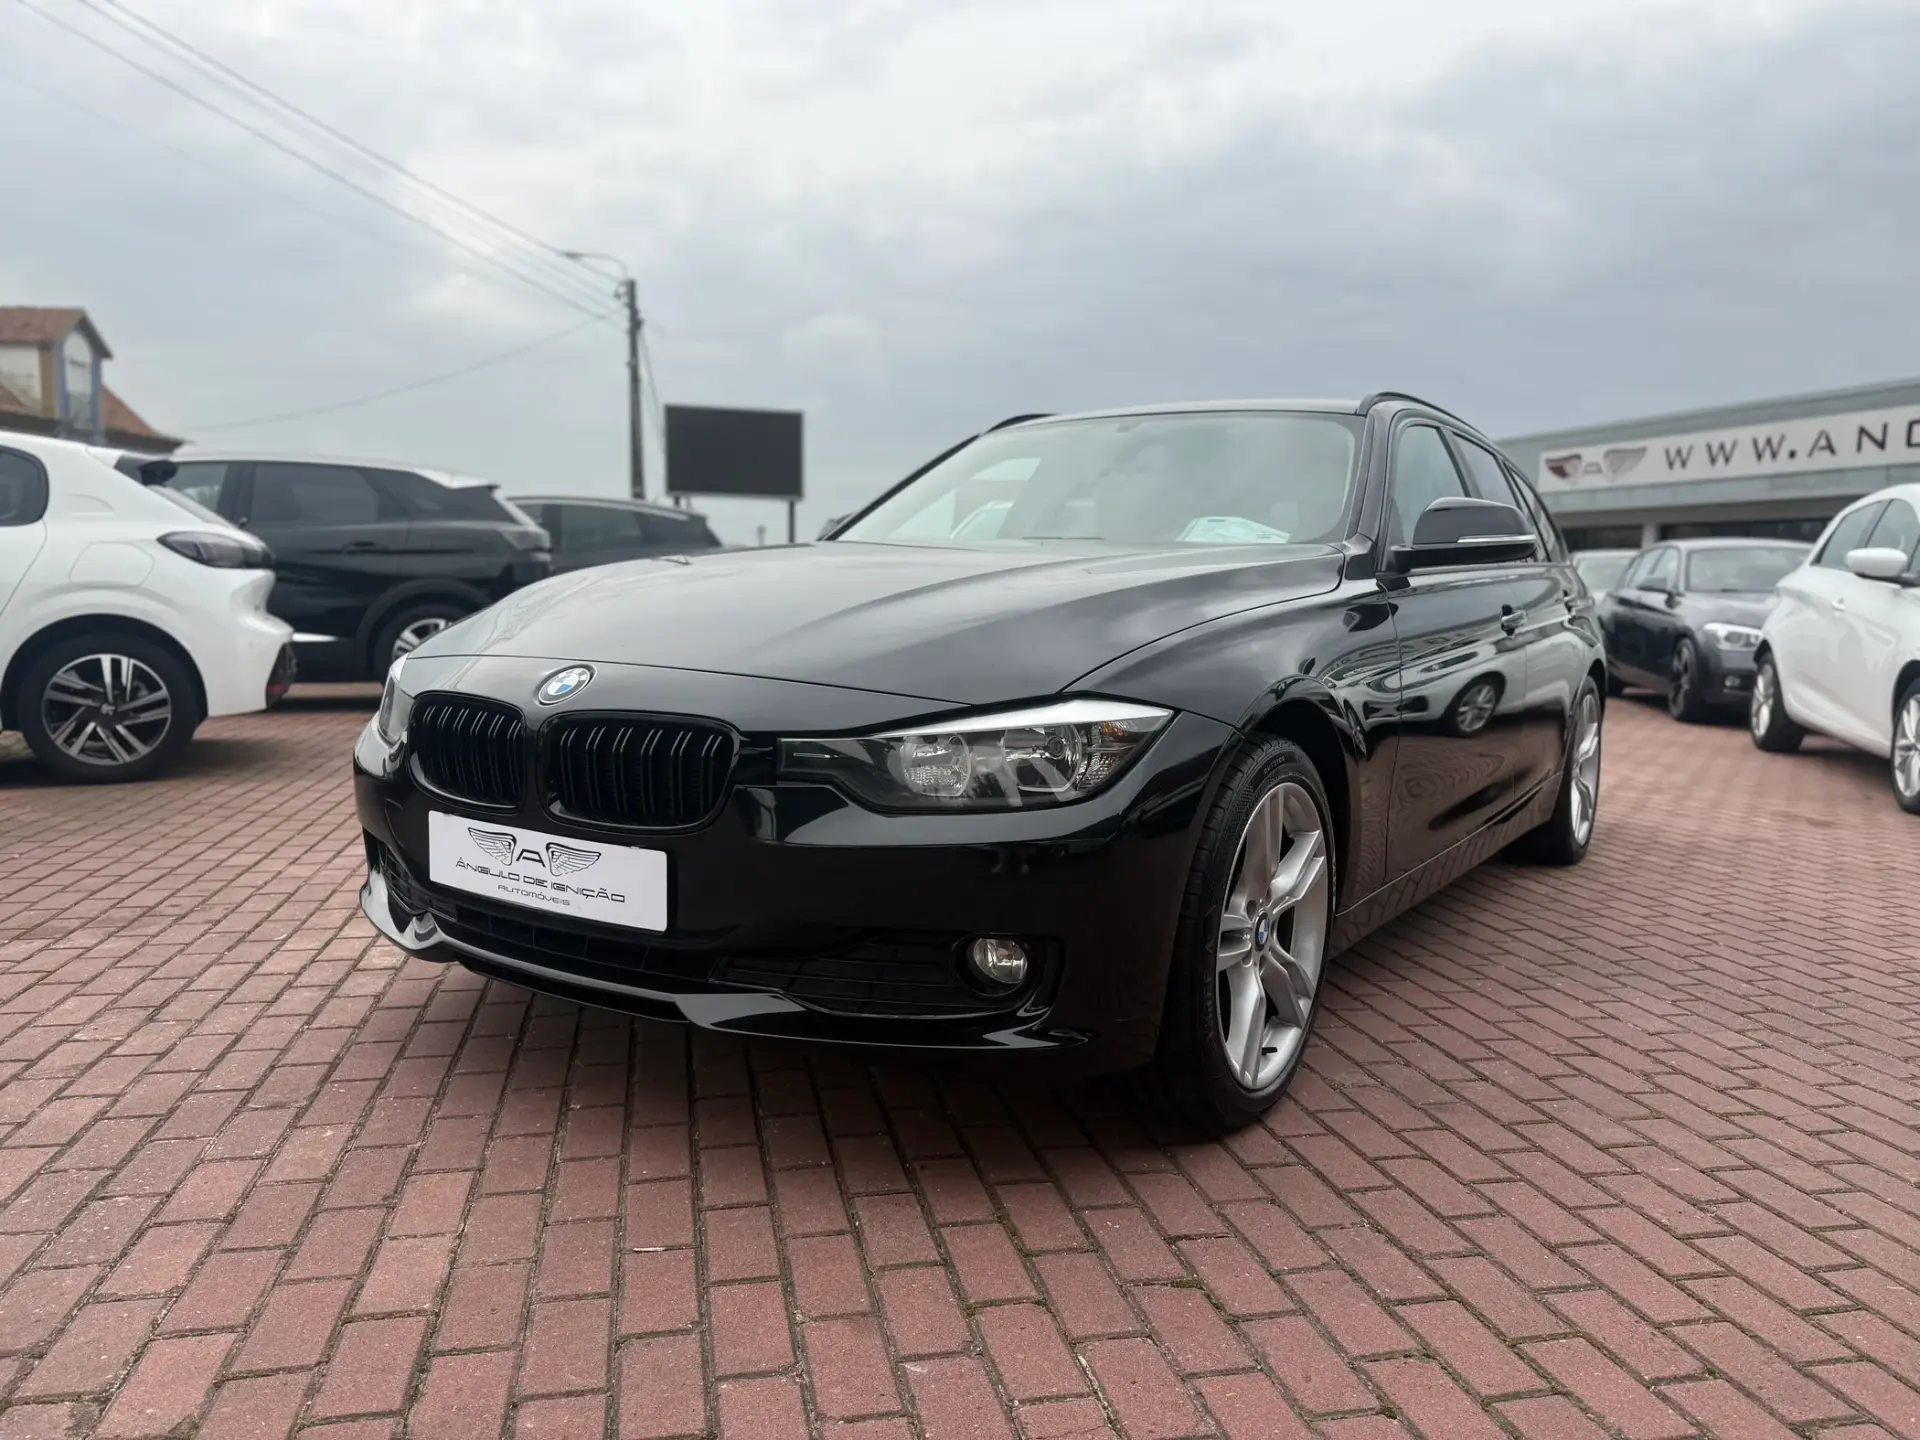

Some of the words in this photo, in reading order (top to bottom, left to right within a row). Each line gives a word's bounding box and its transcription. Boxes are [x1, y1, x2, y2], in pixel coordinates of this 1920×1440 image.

[516, 848, 546, 868] A
[455, 856, 520, 882] ÂNGULO
[523, 876, 548, 889] DE
[550, 880, 626, 904] IGNIÇÃO
[497, 884, 571, 907] AUTOMÓVEIS
